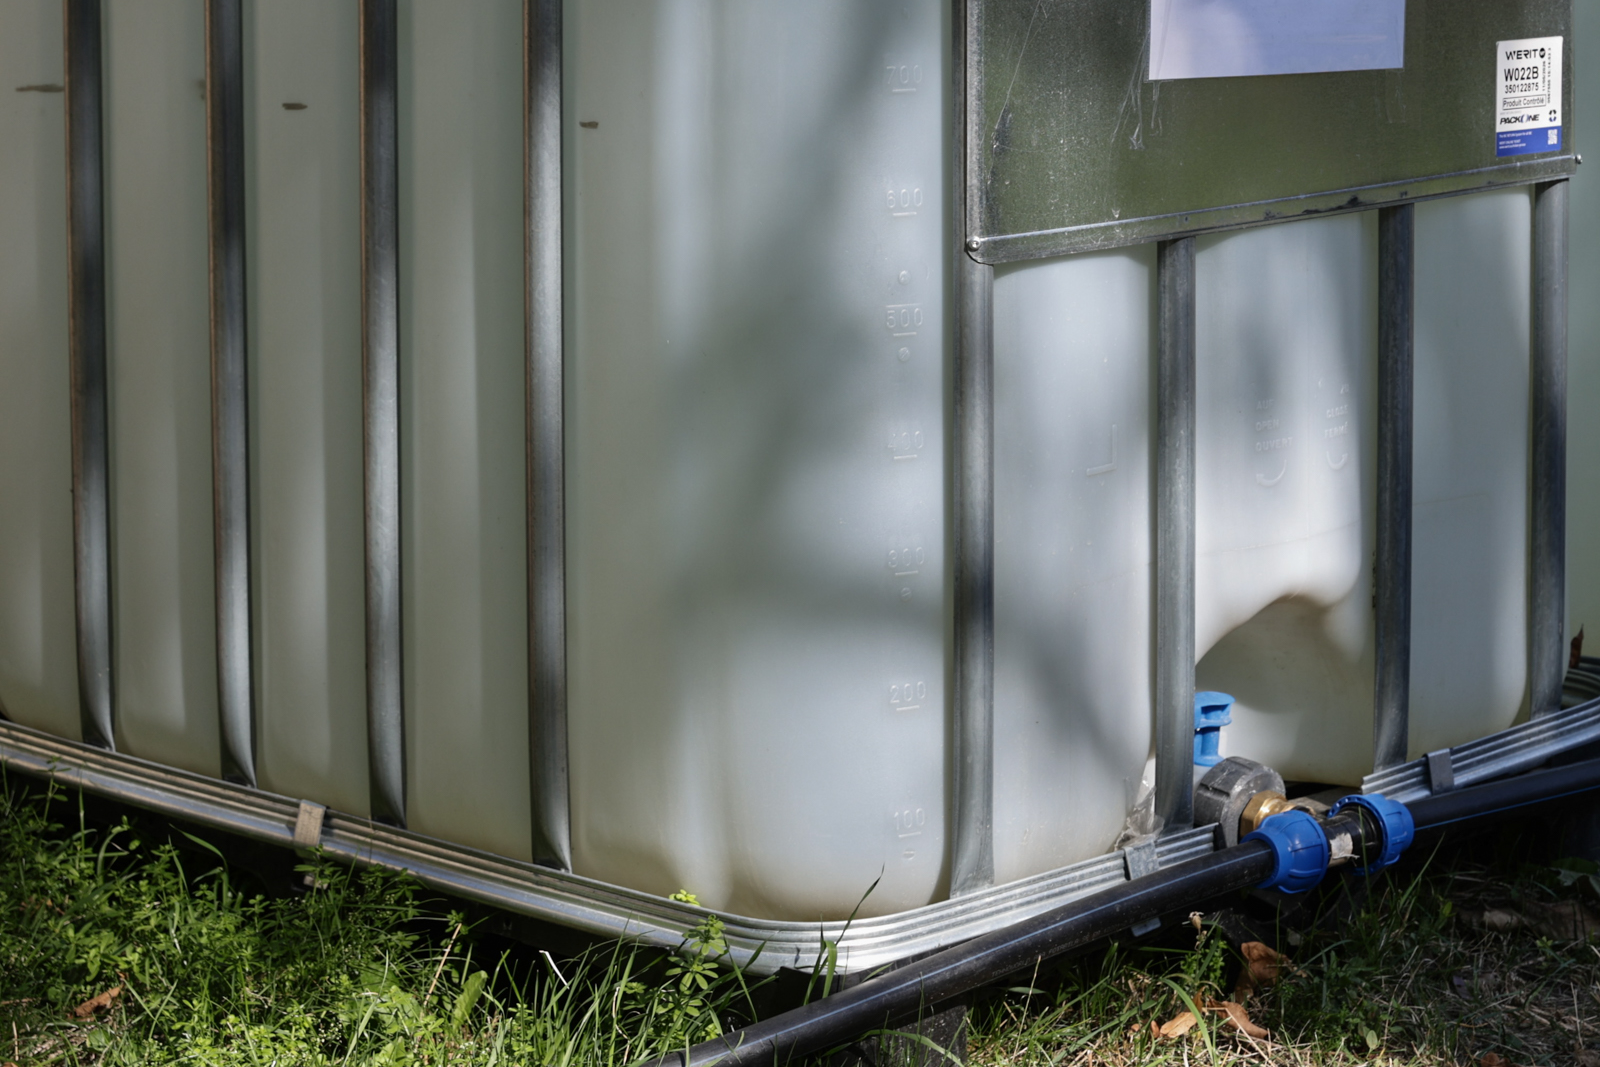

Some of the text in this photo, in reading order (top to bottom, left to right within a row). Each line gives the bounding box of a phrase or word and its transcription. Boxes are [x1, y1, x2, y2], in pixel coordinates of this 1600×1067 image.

[1505, 48, 1539, 60] WERIT
[886, 65, 923, 85] 700
[1504, 66, 1539, 82] W022B
[1503, 99, 1522, 108] Produit
[886, 188, 923, 208] 600
[886, 307, 923, 328] 500
[1255, 419, 1279, 431] OPEN
[887, 431, 924, 451] 400
[1255, 437, 1293, 452] OUVERT
[888, 546, 925, 568] 300
[889, 681, 926, 704] 200
[893, 808, 926, 830] 100
